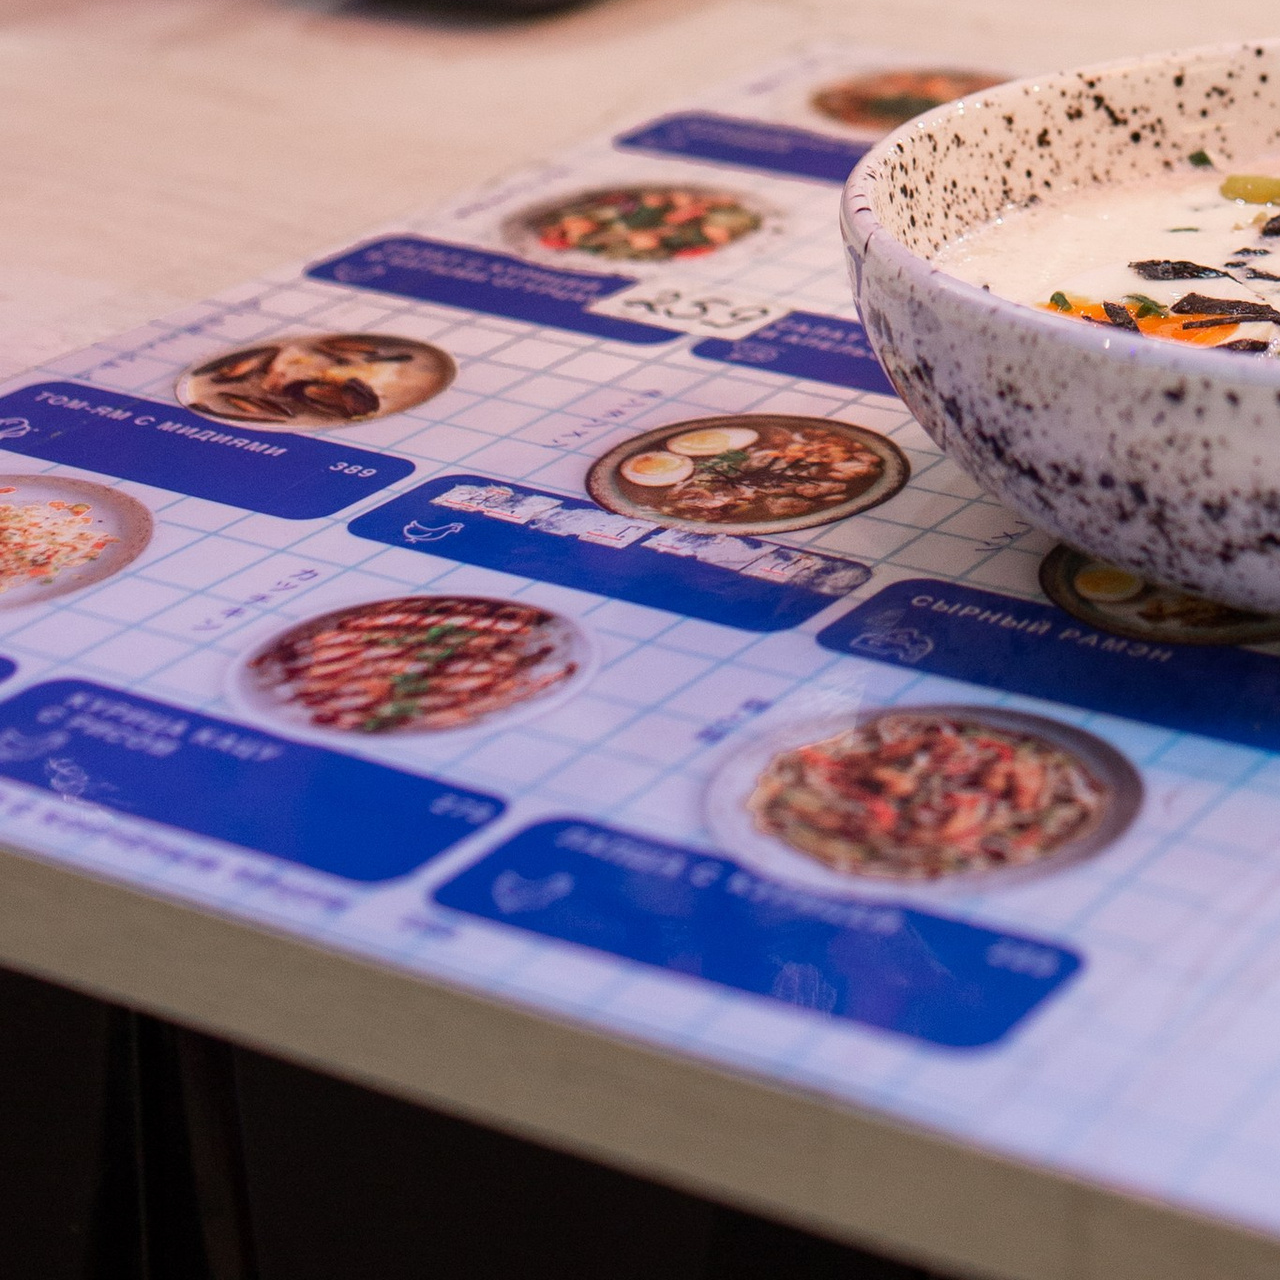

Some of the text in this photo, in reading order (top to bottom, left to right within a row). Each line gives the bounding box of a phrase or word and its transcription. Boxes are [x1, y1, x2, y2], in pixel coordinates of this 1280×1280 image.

[35, 391, 133, 421] ТОМ-ЯМ
[156, 420, 289, 457] МИДИЯМИ
[328, 461, 378, 479] 389
[911, 594, 1174, 664] СЫРНЫЙ РАМЭН
